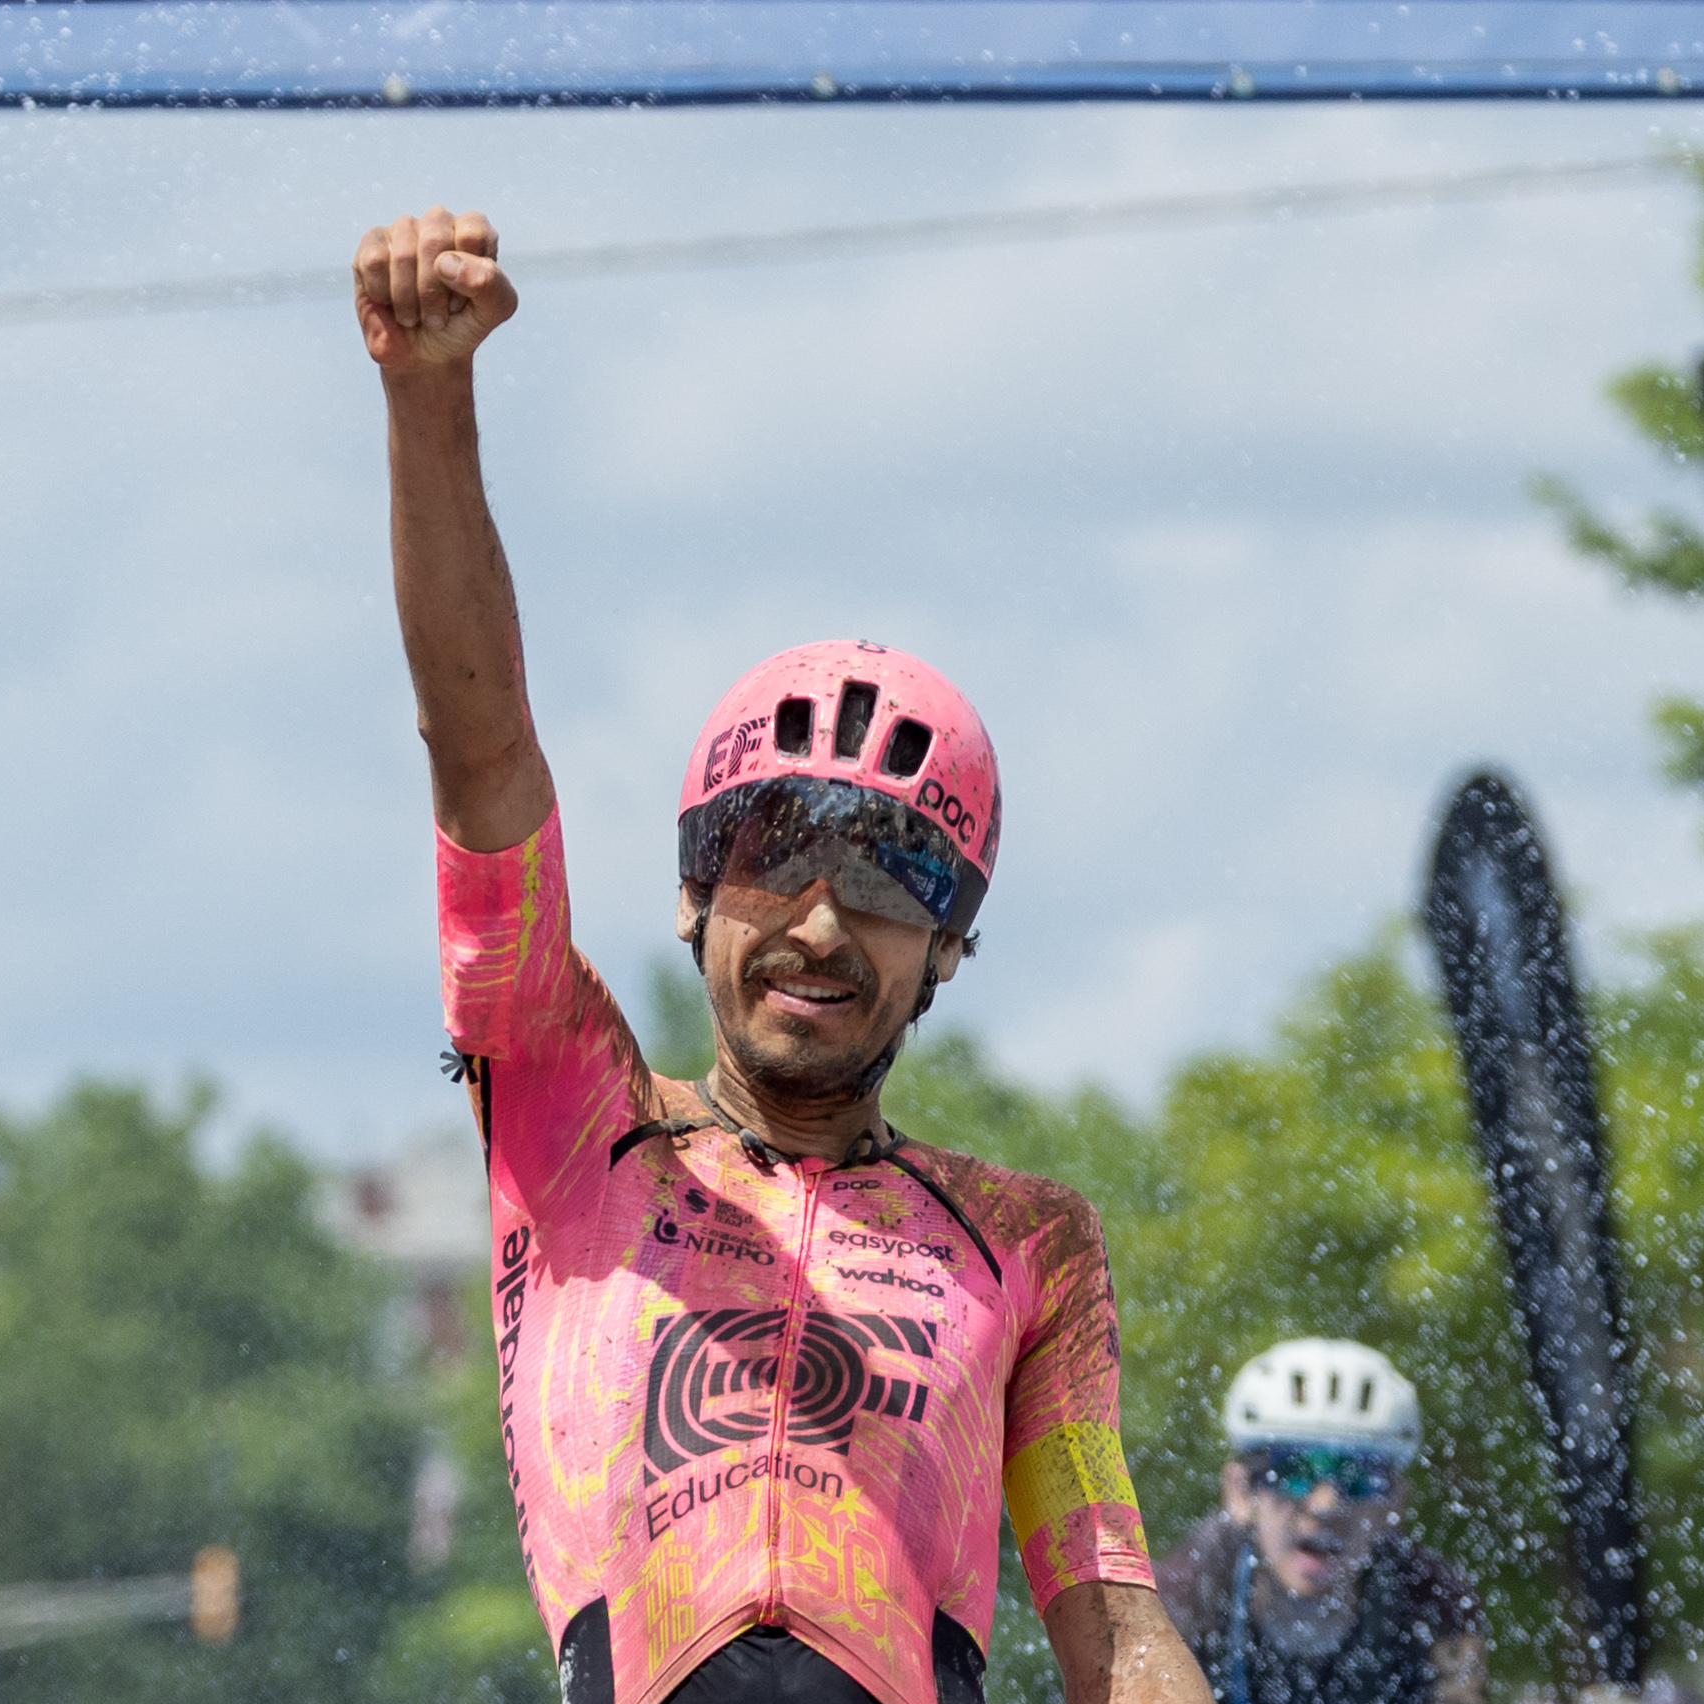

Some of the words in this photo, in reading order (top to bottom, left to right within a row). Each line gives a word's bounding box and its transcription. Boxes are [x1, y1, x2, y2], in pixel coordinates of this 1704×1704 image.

[684, 1231, 775, 1266] NIPPO
[829, 1229, 956, 1263] easypost
[837, 1265, 945, 1298] wahoo
[646, 1451, 843, 1542] Education
